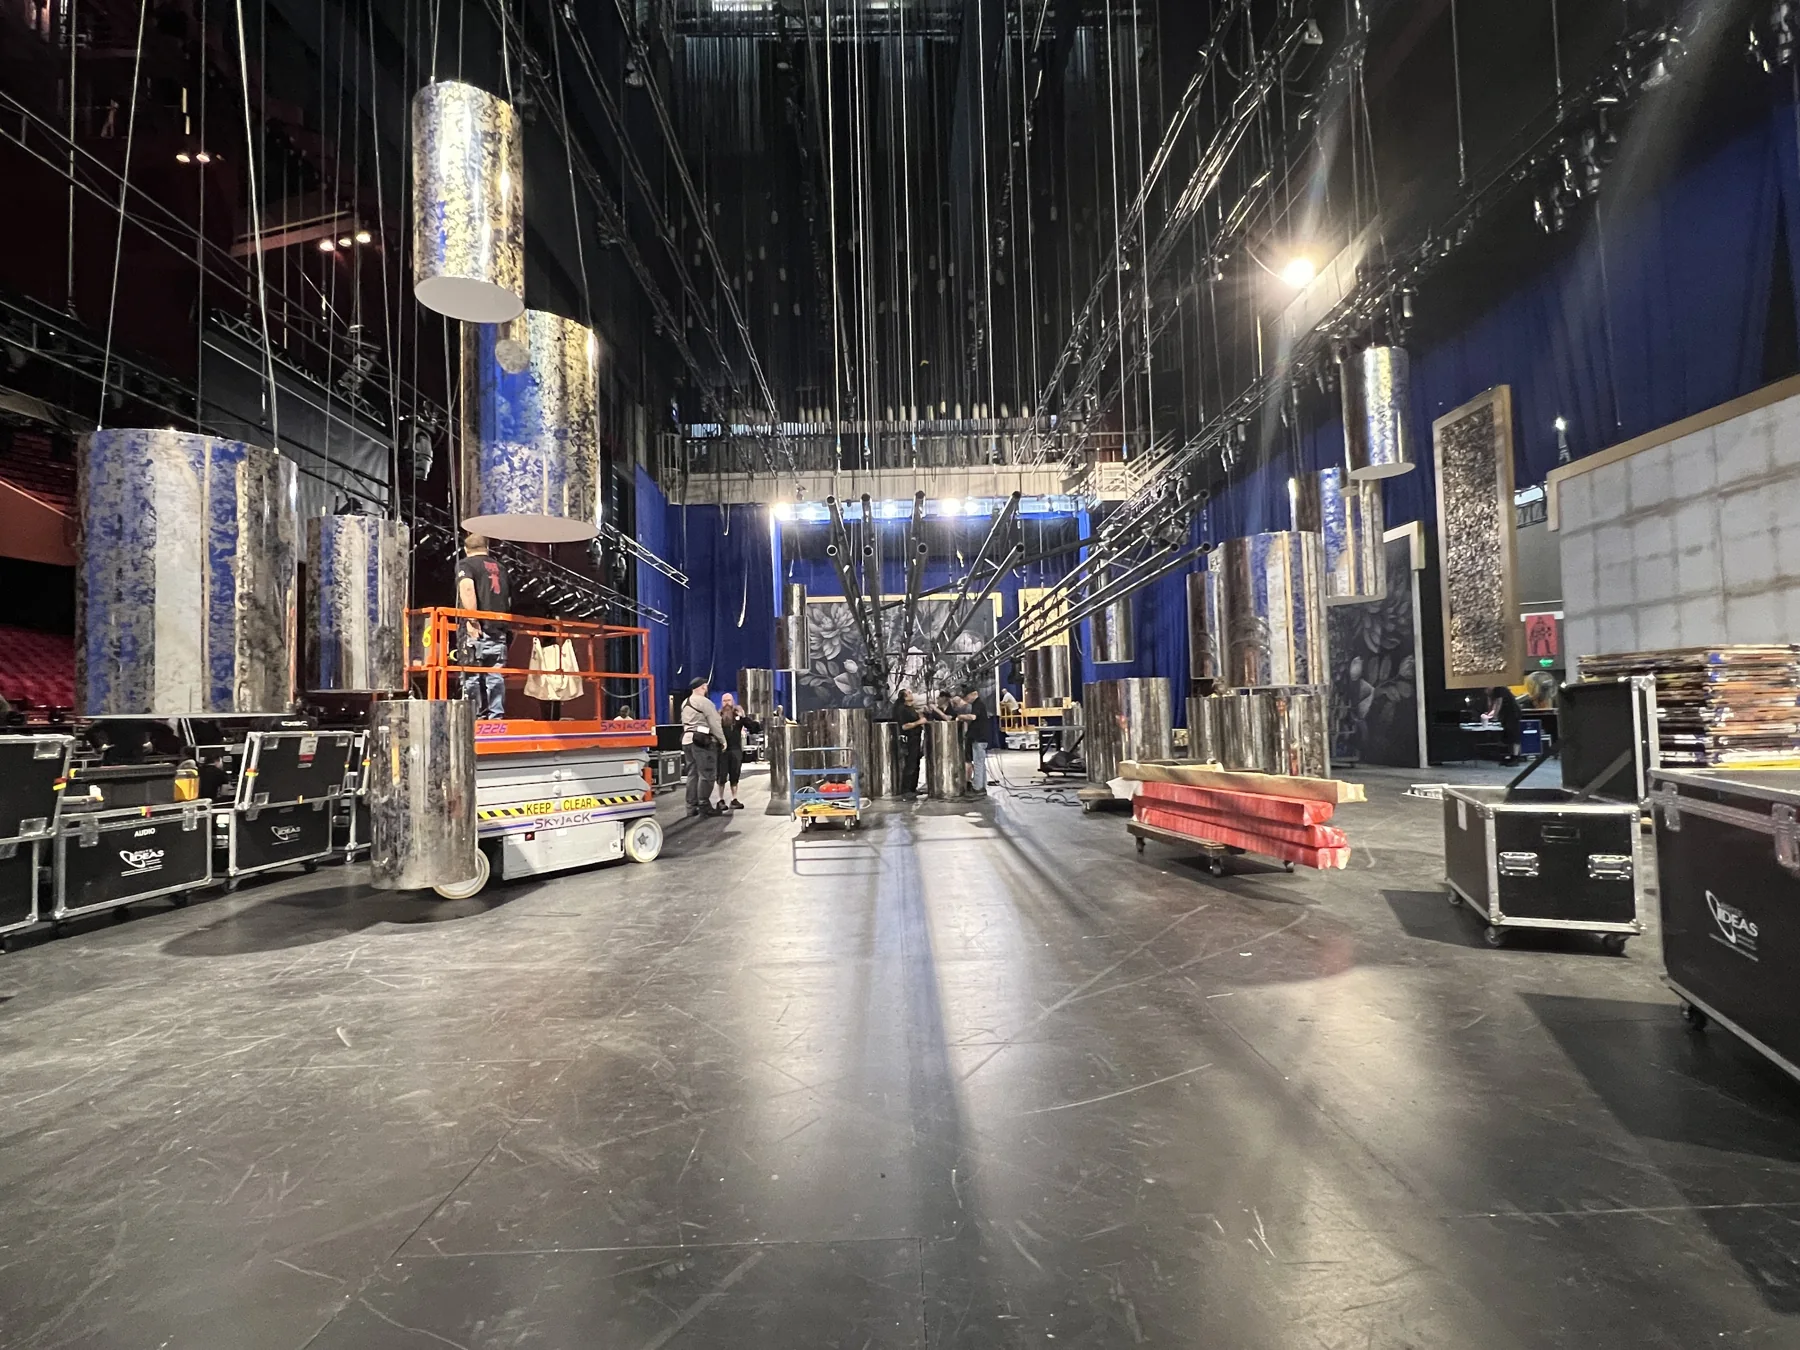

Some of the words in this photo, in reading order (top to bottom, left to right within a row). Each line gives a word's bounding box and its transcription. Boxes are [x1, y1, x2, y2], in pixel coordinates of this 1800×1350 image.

[476, 723, 508, 735] 3226
[600, 721, 648, 732] SKYJACK
[525, 802, 552, 816] KEEP
[534, 812, 591, 830] SKYJACK
[133, 827, 156, 838] AUDIO
[129, 849, 165, 862] IDEAS
[1717, 906, 1759, 937] IDEAS
